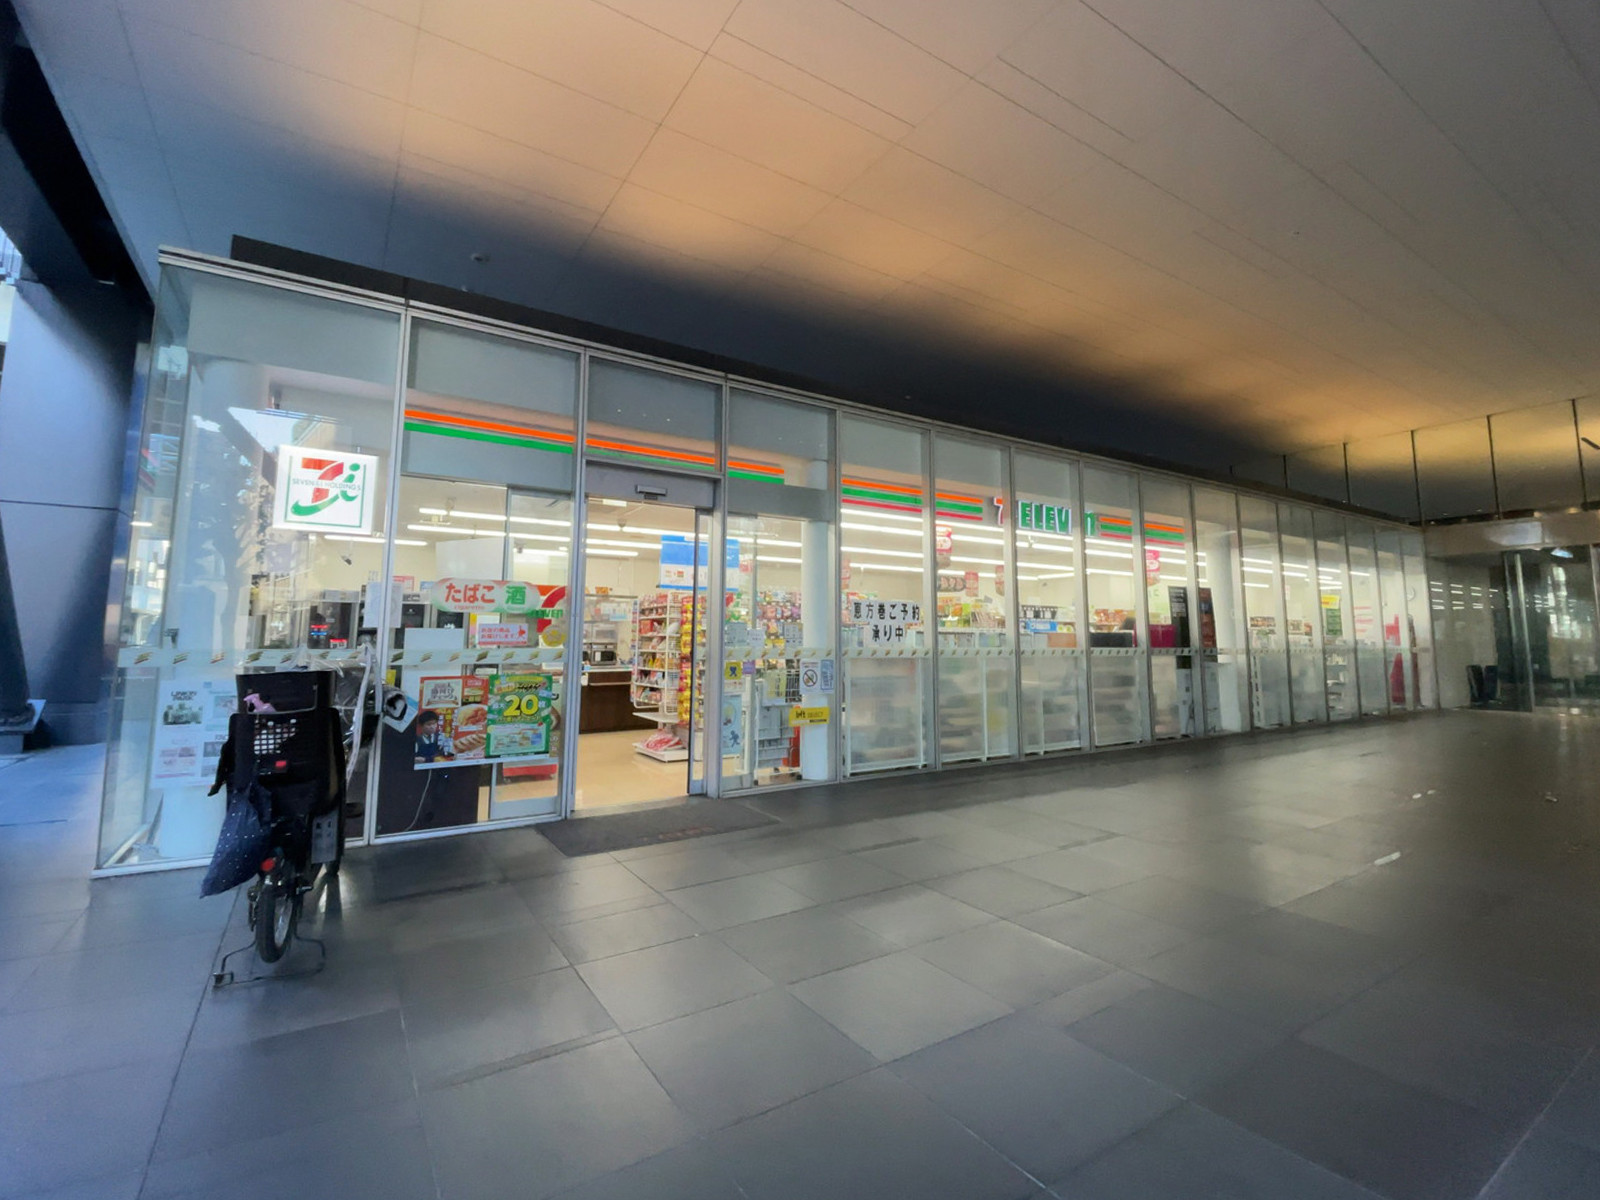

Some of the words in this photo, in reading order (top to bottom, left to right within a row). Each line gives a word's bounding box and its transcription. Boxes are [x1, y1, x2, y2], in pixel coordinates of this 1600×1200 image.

[444, 582, 495, 604] たばこ
[505, 584, 527, 605] 酒
[872, 624, 904, 642] 承り中
[503, 694, 540, 717] 20
